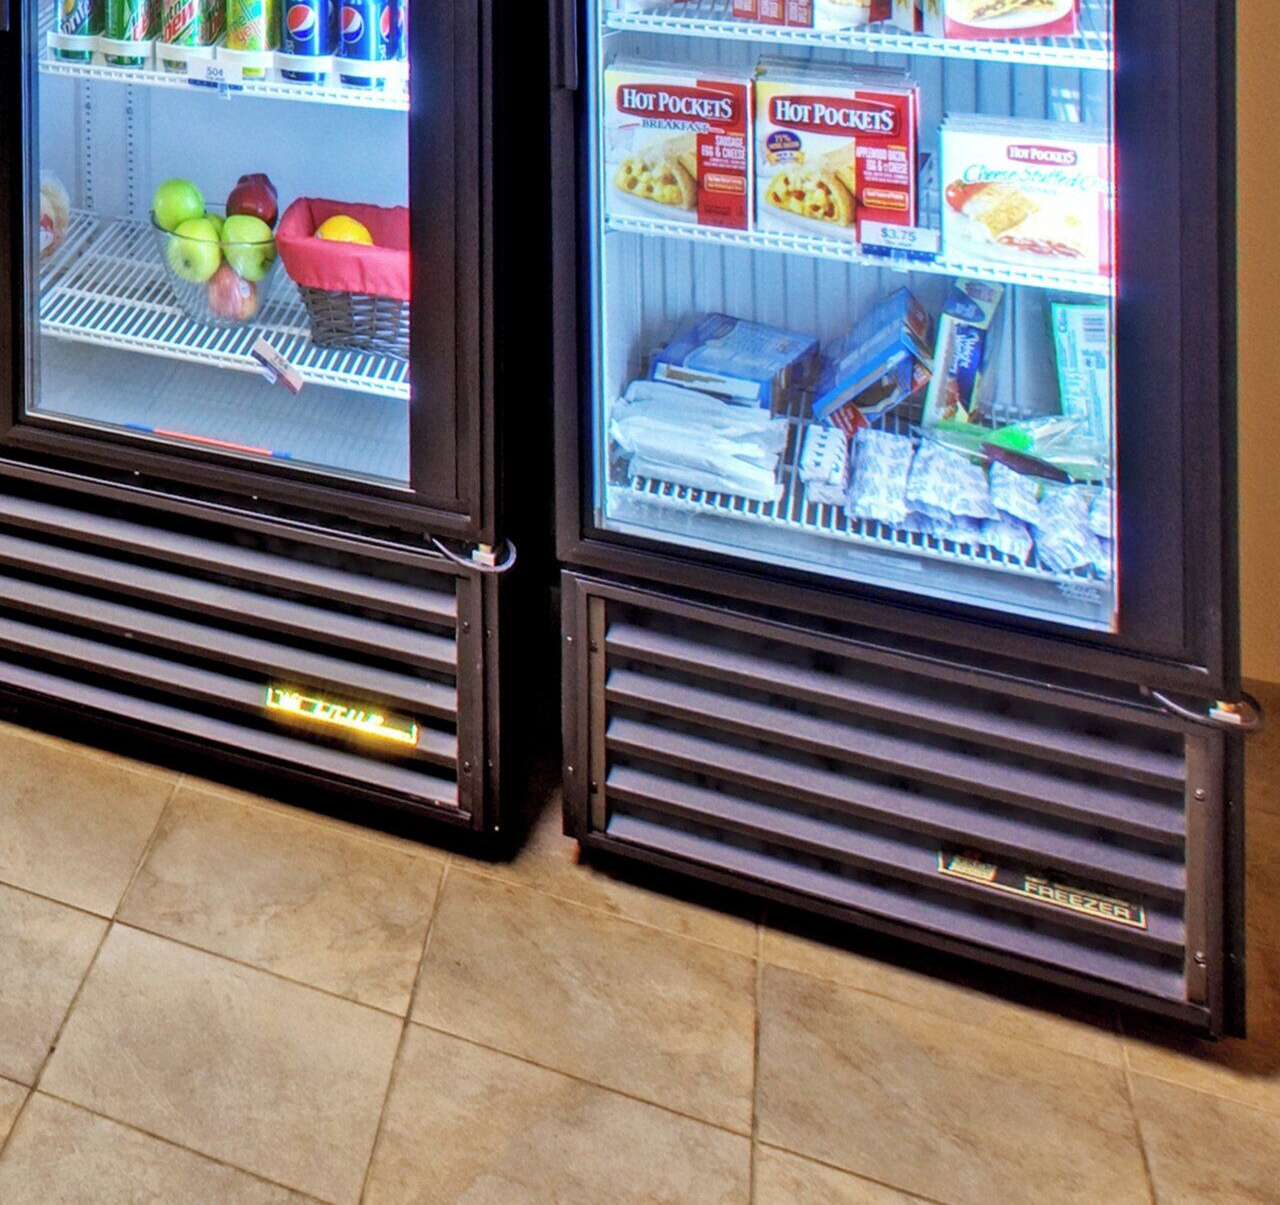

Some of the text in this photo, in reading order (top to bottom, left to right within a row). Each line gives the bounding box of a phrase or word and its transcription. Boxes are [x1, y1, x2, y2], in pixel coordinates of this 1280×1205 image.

[622, 88, 733, 119] HOT POCKETS
[775, 99, 895, 131] HOT POCKETS
[1010, 146, 1076, 163] HOT POCKETS
[881, 227, 917, 242] $3.75
[1024, 881, 1131, 920] FREEZER
